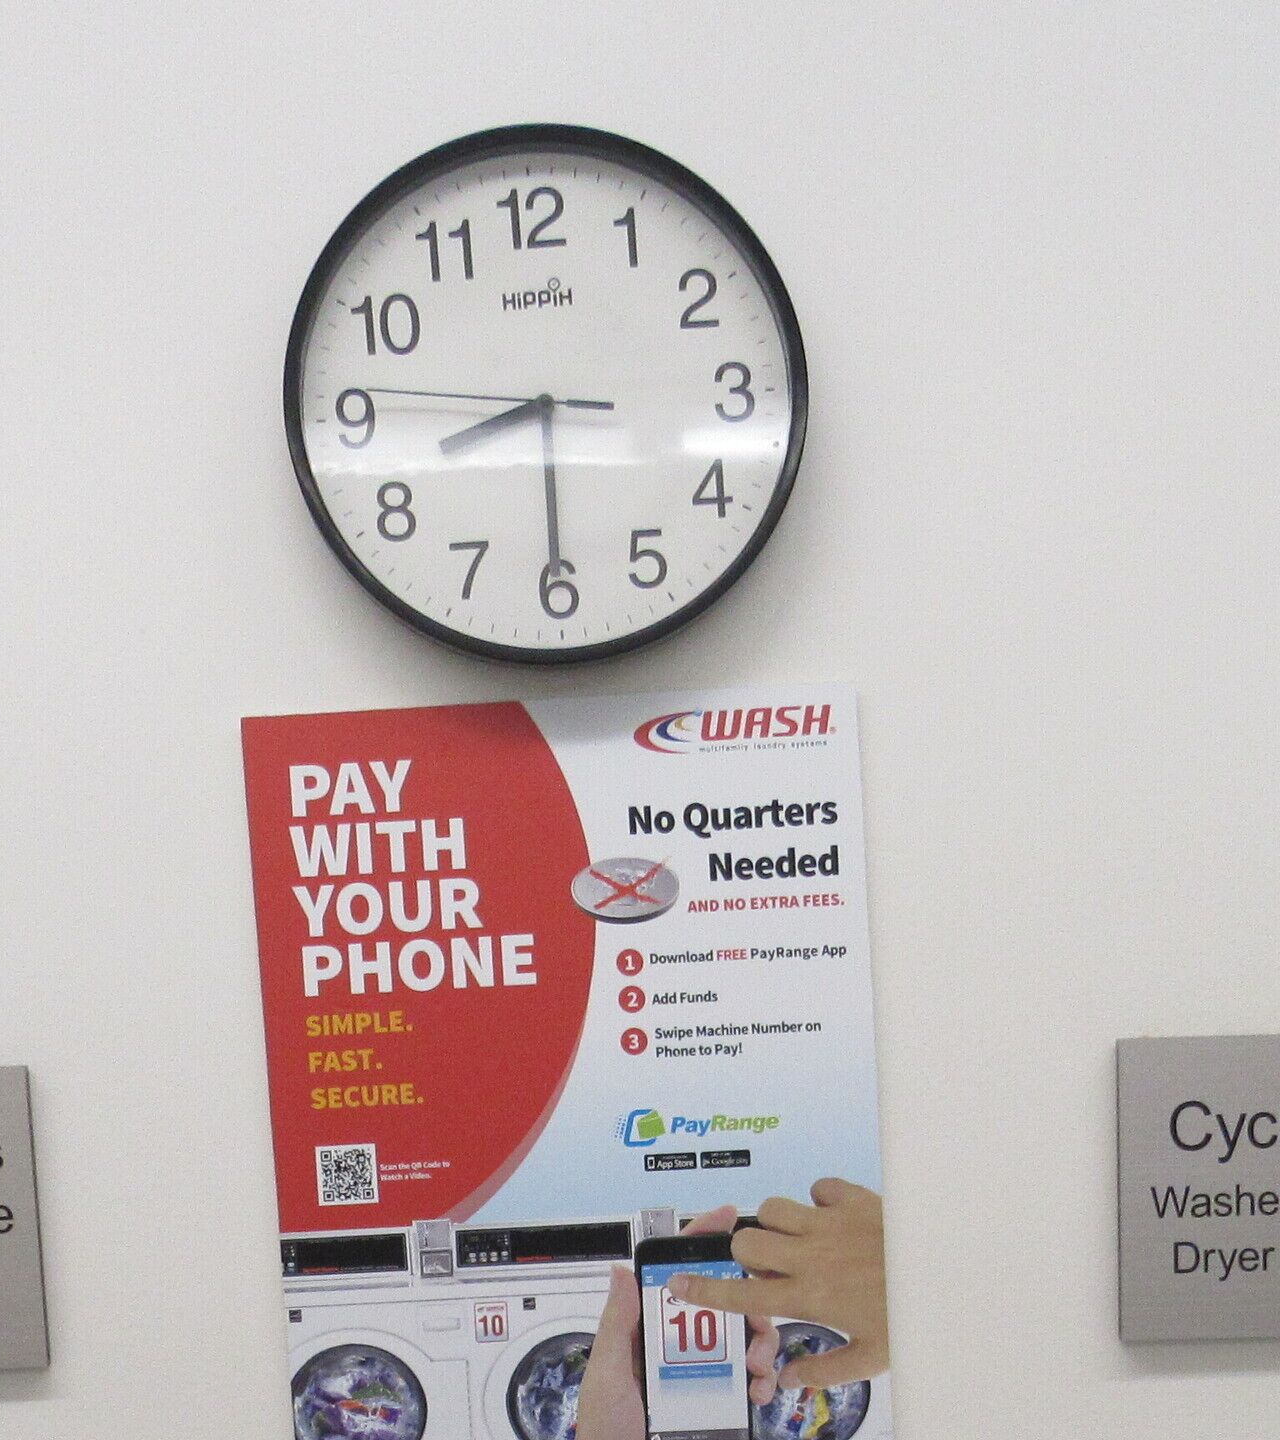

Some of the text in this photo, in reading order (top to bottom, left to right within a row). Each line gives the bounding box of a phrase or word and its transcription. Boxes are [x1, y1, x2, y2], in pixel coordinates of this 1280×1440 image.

[497, 186, 567, 250] 12
[613, 207, 637, 268] 1
[415, 219, 473, 282] 11
[679, 269, 719, 328] 2
[351, 294, 420, 355] 10
[714, 362, 755, 422] 3
[335, 388, 375, 448] 9
[376, 482, 417, 541] 8
[691, 459, 733, 518] 4
[449, 541, 489, 600] 7
[628, 529, 667, 588] 5
[538, 559, 579, 619] 6
[701, 704, 831, 741] WASH
[288, 759, 412, 817] PAY
[628, 799, 838, 839] No Quarters
[290, 818, 466, 878] WITH
[708, 846, 839, 881] Needed
[293, 878, 482, 937] YOUR
[688, 894, 844, 912] AND NO EXTRA FEES.
[301, 934, 537, 997] PHONE
[625, 945, 847, 970] 1 Download FREE PayRange App
[627, 991, 718, 1006] 2 Add Funds
[306, 1011, 413, 1037] SIMPLE.
[629, 1022, 821, 1048] 3 Swipe Machine Number on
[308, 1049, 383, 1072] FAST.
[656, 1043, 742, 1058] Phone to Pay!
[311, 1083, 424, 1109] SECURE.
[671, 1115, 780, 1137] PayRange
[657, 1159, 694, 1170] App Store
[1173, 1241, 1275, 1281] Dryer
[479, 1315, 503, 1337] 10
[670, 1310, 717, 1352] 10
